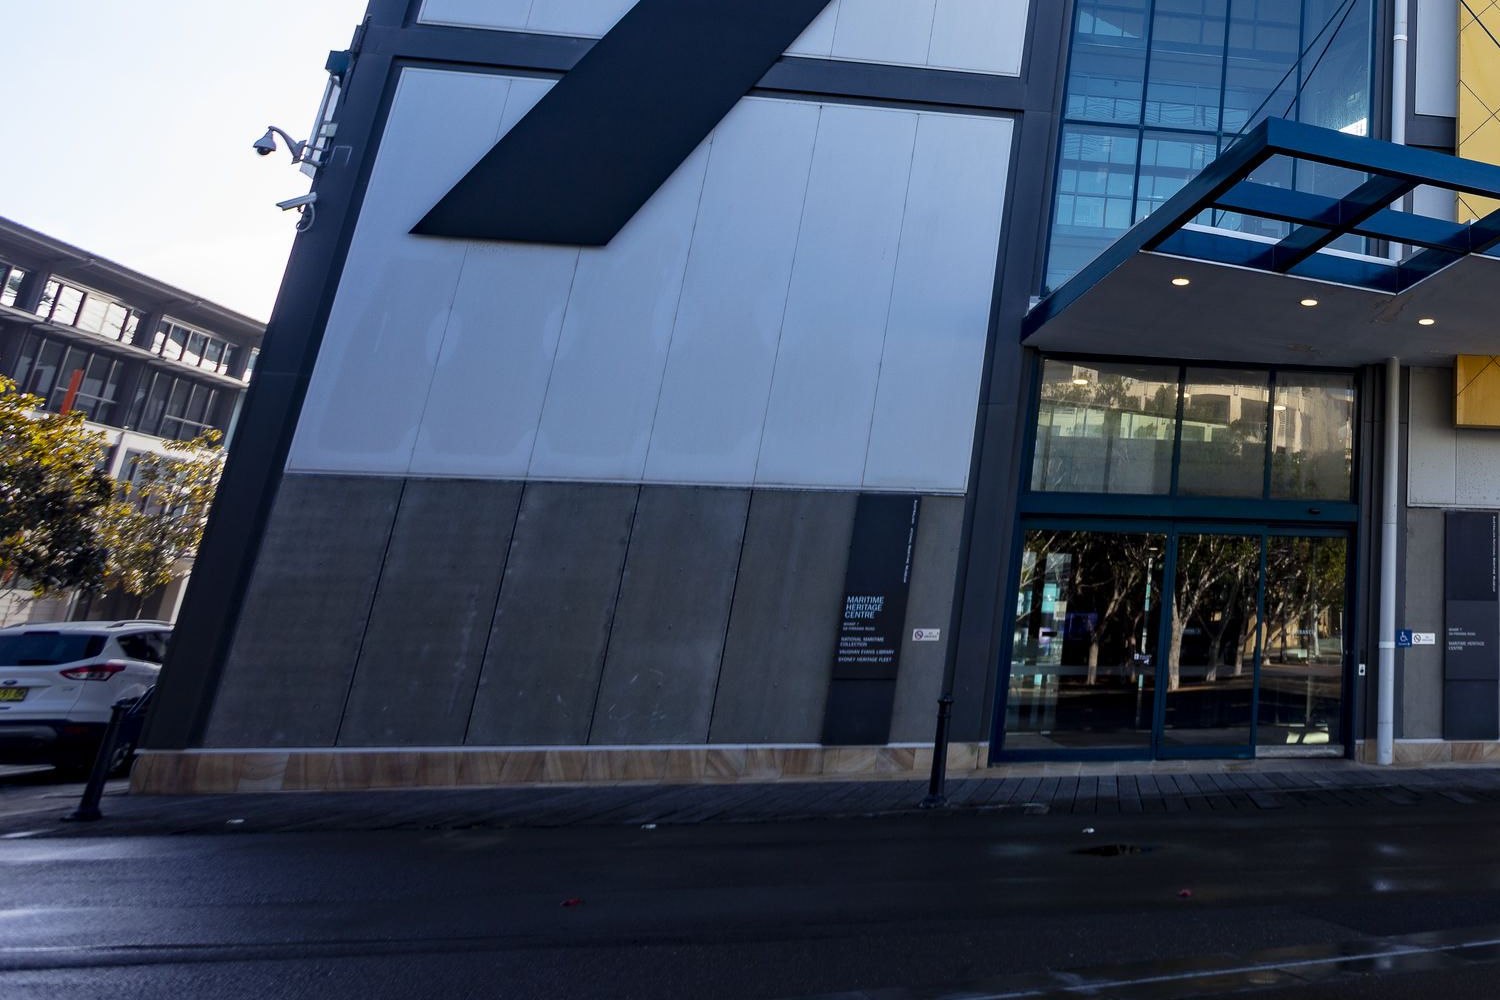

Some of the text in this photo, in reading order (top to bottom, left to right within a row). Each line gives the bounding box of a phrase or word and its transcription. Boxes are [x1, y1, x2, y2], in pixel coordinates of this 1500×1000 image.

[846, 595, 885, 604] MARITIME
[845, 603, 882, 611] HERITAGE
[844, 611, 875, 619] CENTRE
